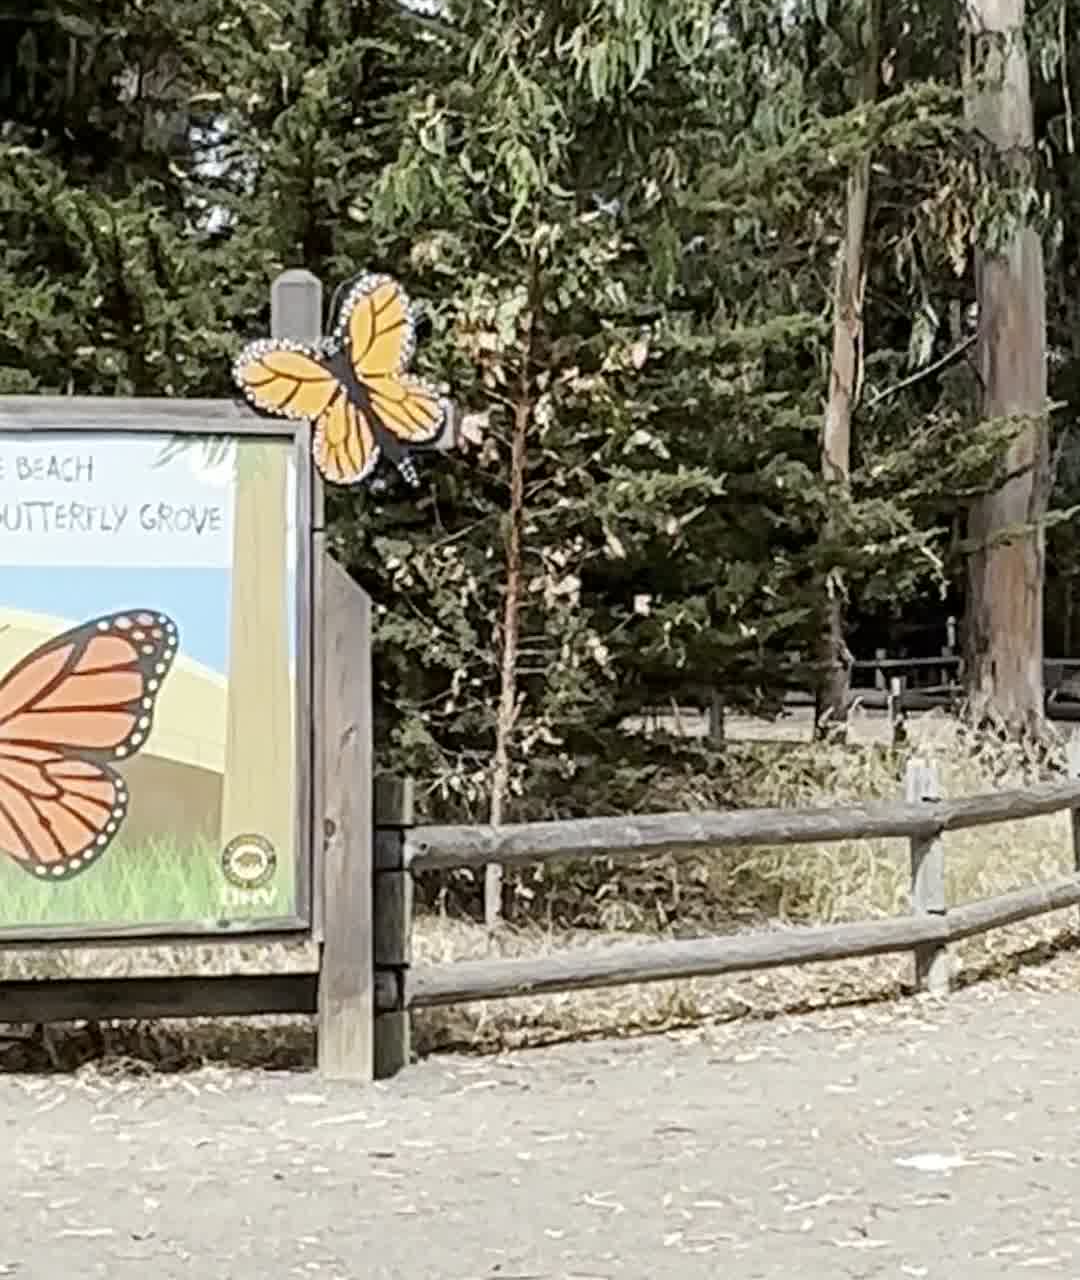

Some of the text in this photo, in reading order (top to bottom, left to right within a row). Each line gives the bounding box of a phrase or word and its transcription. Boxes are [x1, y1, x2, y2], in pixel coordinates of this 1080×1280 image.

[16, 455, 93, 482] BEACH
[0, 501, 221, 534] UTTERFLY GROVE
